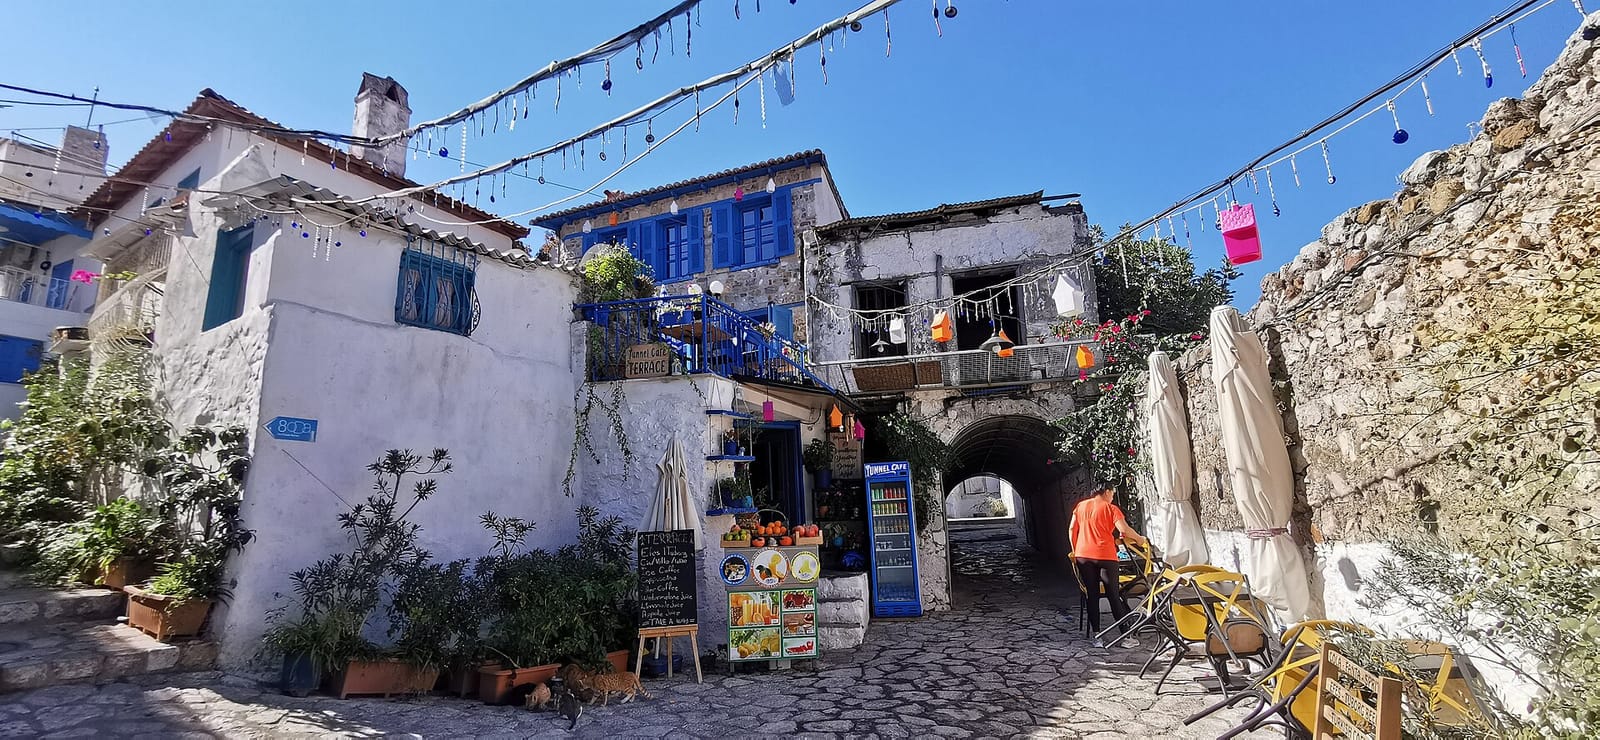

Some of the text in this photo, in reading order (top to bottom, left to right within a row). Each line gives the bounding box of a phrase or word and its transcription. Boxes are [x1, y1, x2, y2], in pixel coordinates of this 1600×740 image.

[629, 349, 650, 360] Tunnel
[629, 359, 666, 376] TERRACE
[864, 464, 891, 478] TUNNEL
[891, 463, 908, 471] CAFE
